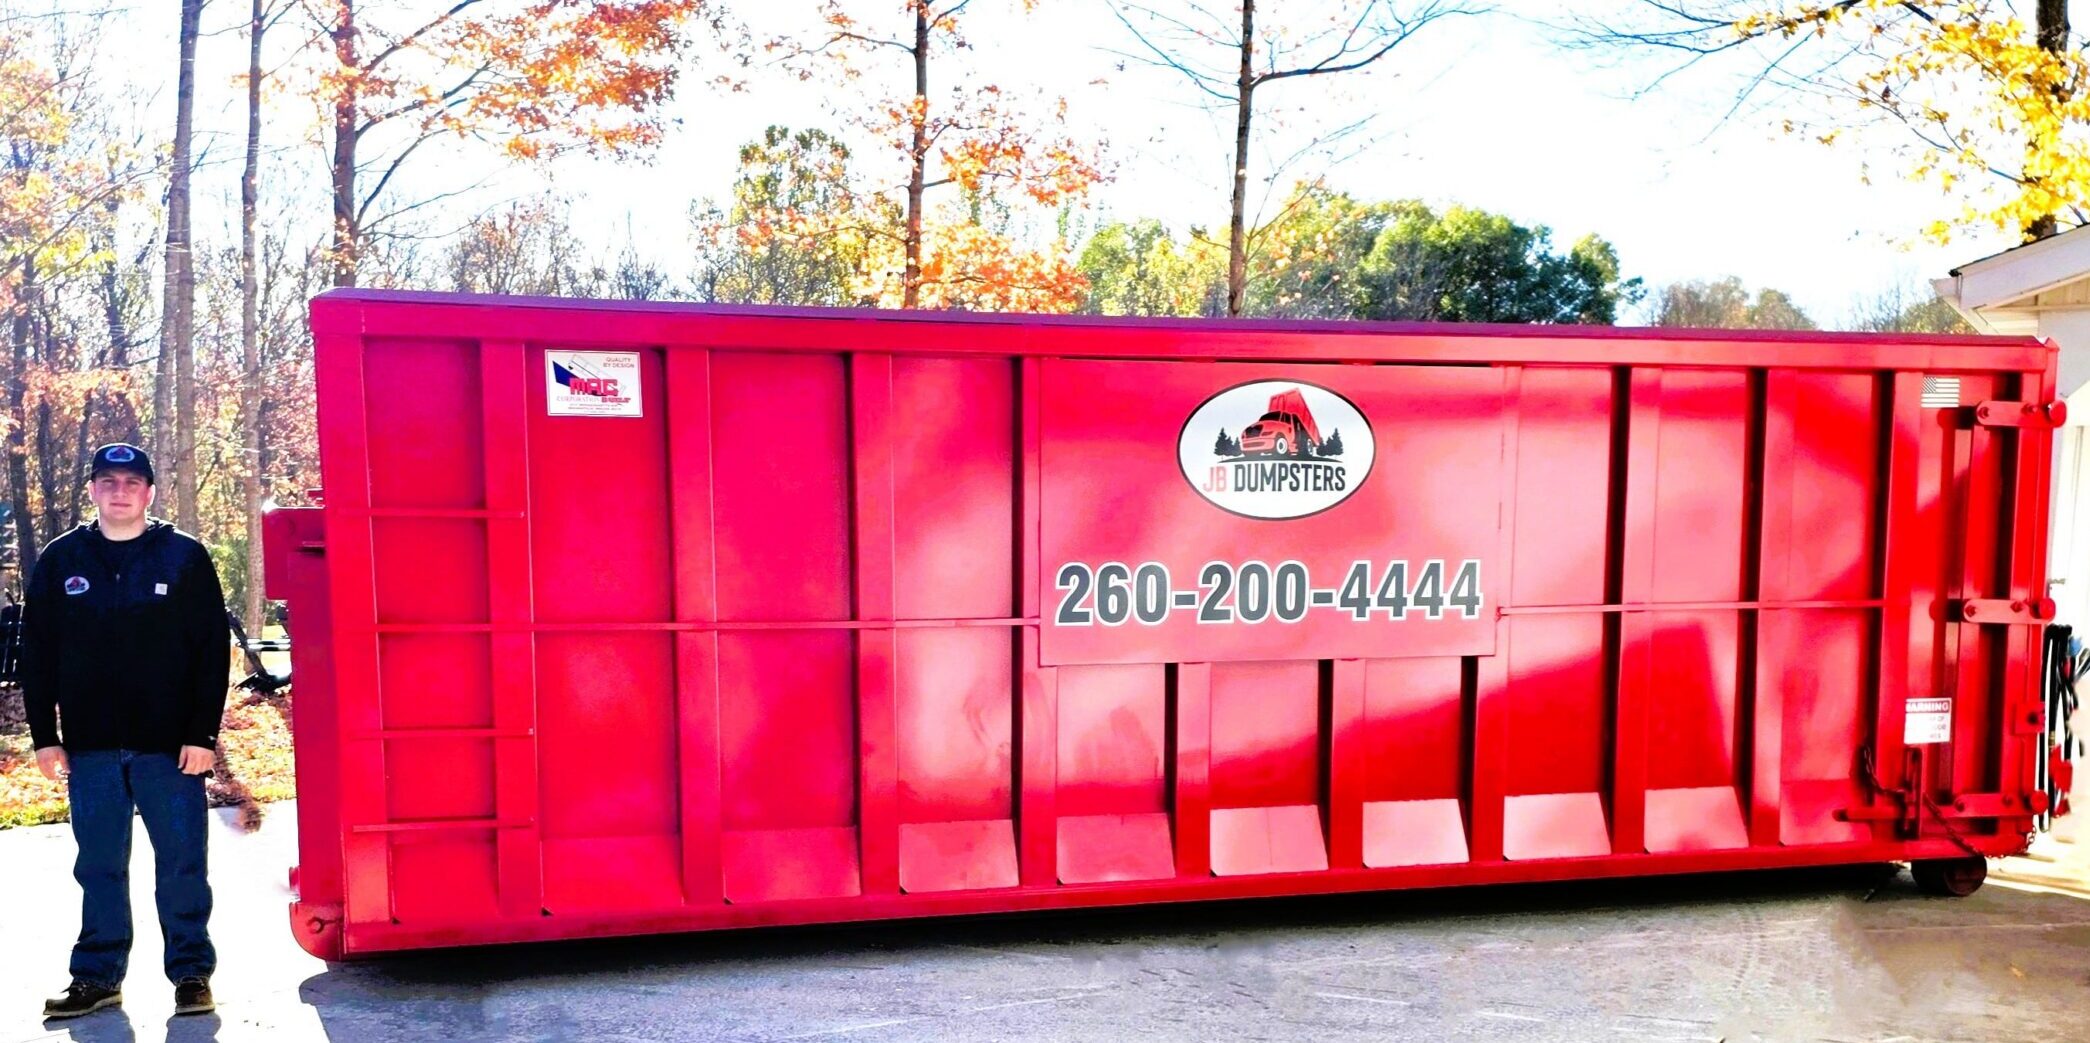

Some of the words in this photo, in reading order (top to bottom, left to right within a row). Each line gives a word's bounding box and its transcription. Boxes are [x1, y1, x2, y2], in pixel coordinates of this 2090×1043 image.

[1202, 465, 1228, 493] JB
[1234, 462, 1346, 492] DUMPSTERS
[1055, 559, 1484, 626] 260-200-4444
